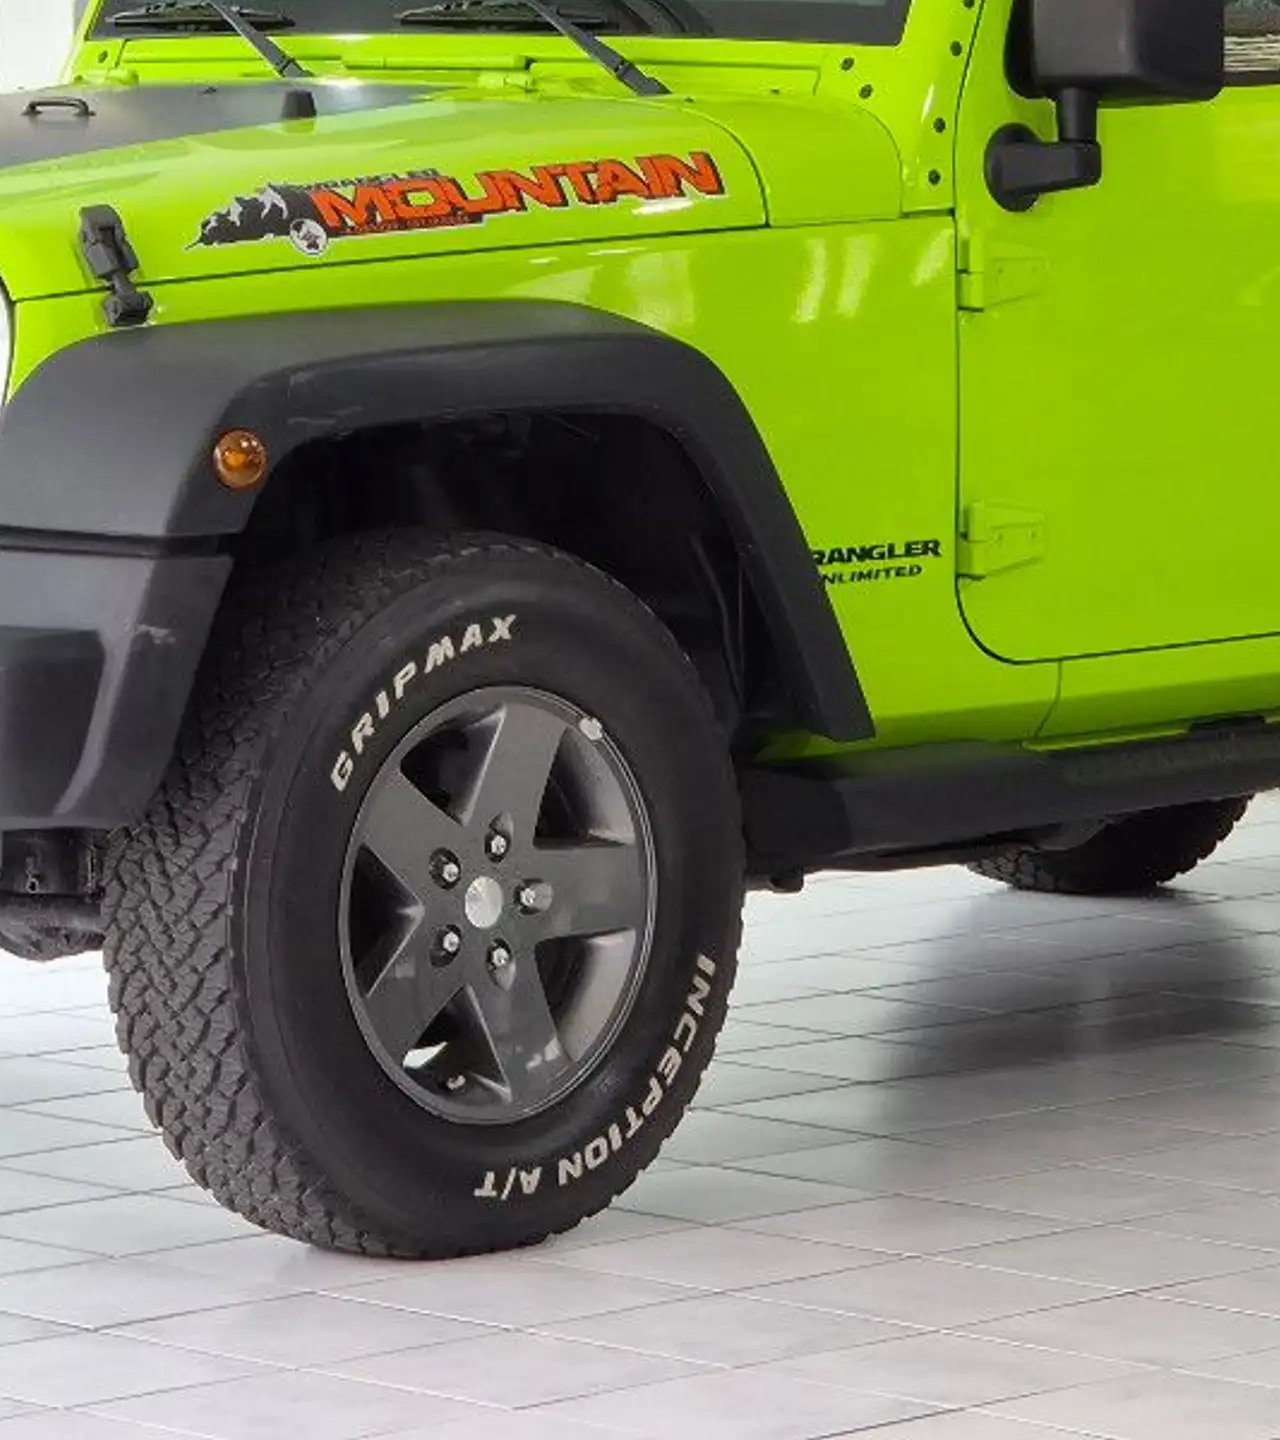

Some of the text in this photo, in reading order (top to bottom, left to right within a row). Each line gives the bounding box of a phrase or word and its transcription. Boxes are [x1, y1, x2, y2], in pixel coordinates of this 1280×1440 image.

[310, 150, 723, 234] MOUNTAIN
[811, 538, 942, 565] RANGLER
[820, 564, 922, 584] NLIMITED
[329, 613, 517, 792] GRIPMAX
[473, 954, 716, 1201] INCEPTION A/T
